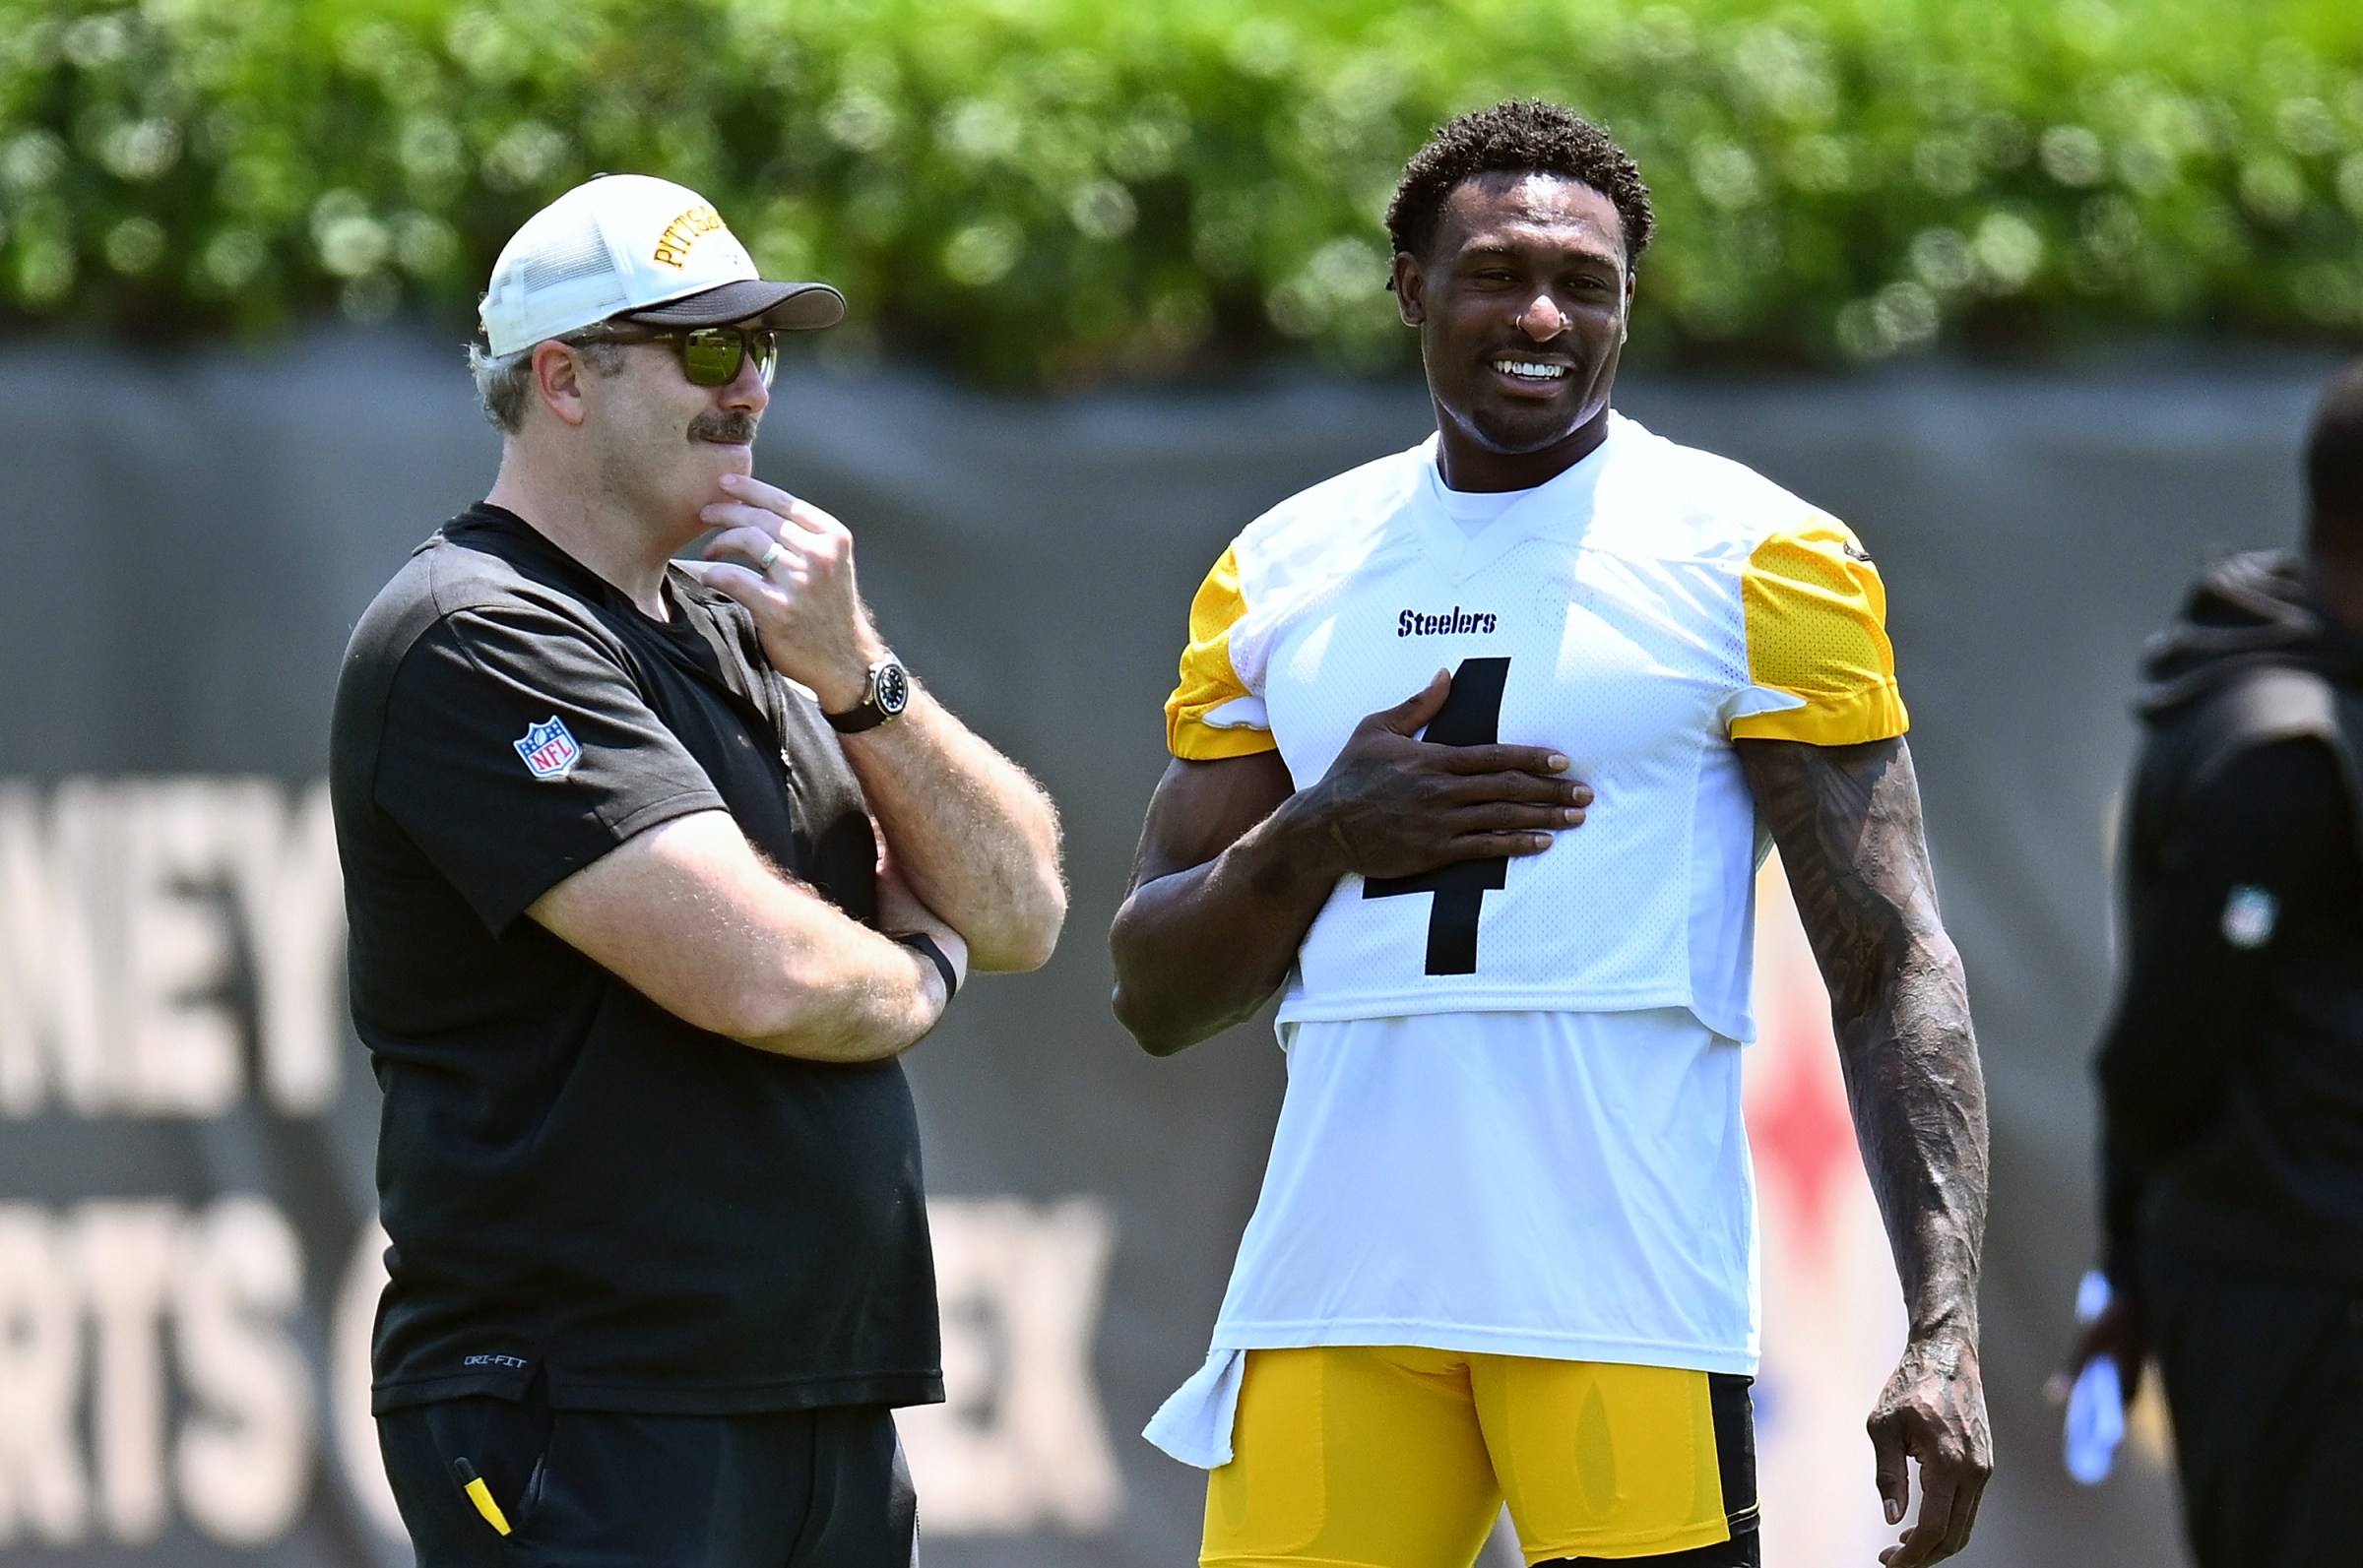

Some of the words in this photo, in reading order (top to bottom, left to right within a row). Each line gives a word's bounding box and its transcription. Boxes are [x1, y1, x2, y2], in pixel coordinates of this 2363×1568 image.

[1397, 605, 1497, 638] Steelers
[530, 738, 572, 771] NFL
[1362, 657, 1512, 975] 4
[464, 1354, 528, 1368] DRI-FIT
